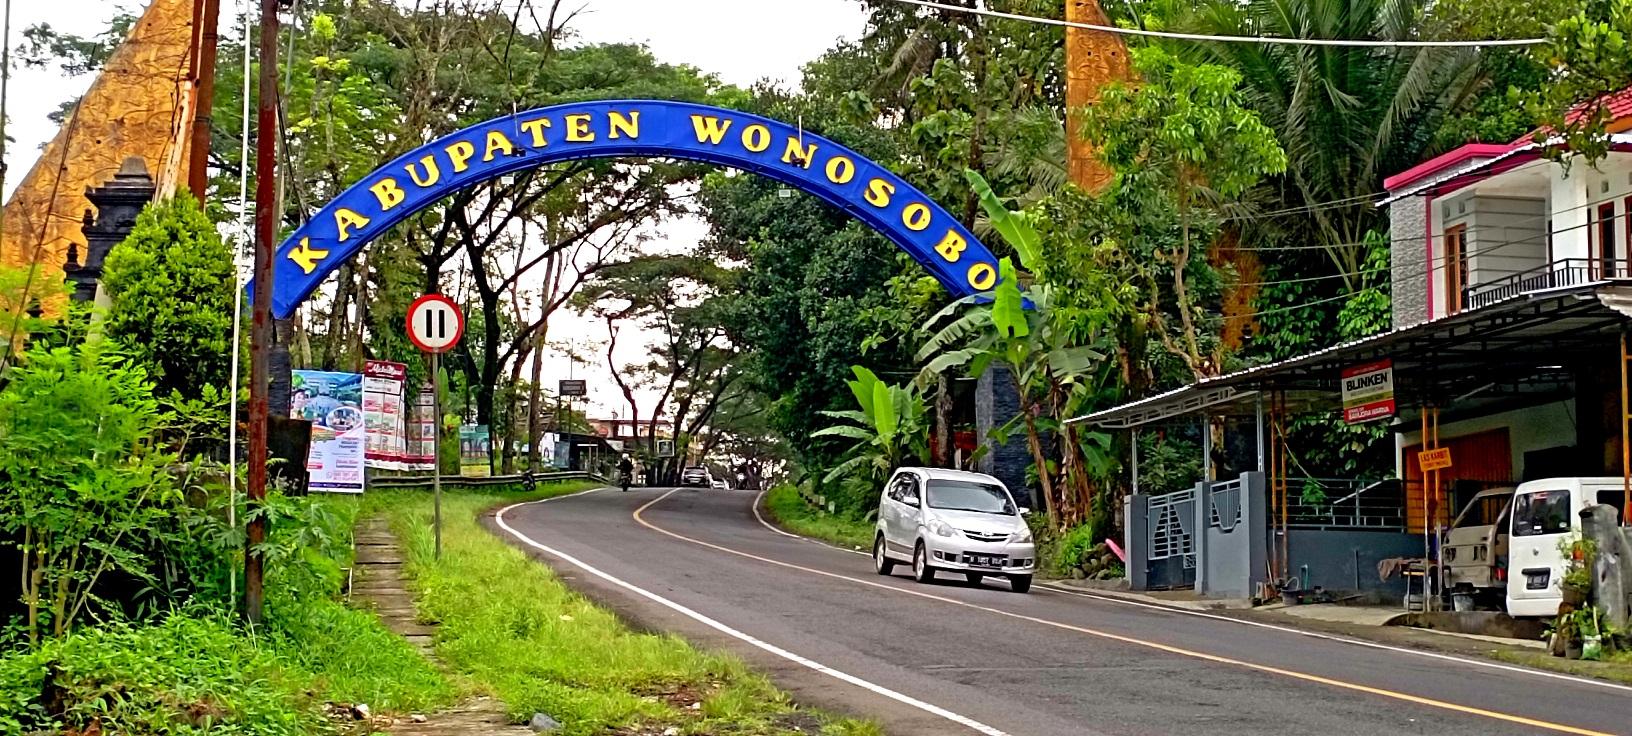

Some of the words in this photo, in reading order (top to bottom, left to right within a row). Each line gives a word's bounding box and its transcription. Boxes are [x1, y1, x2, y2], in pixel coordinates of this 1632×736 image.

[288, 111, 640, 275] KABUPATEN
[690, 114, 997, 291] WONOSOBO
[1346, 372, 1388, 392] BLINKEN
